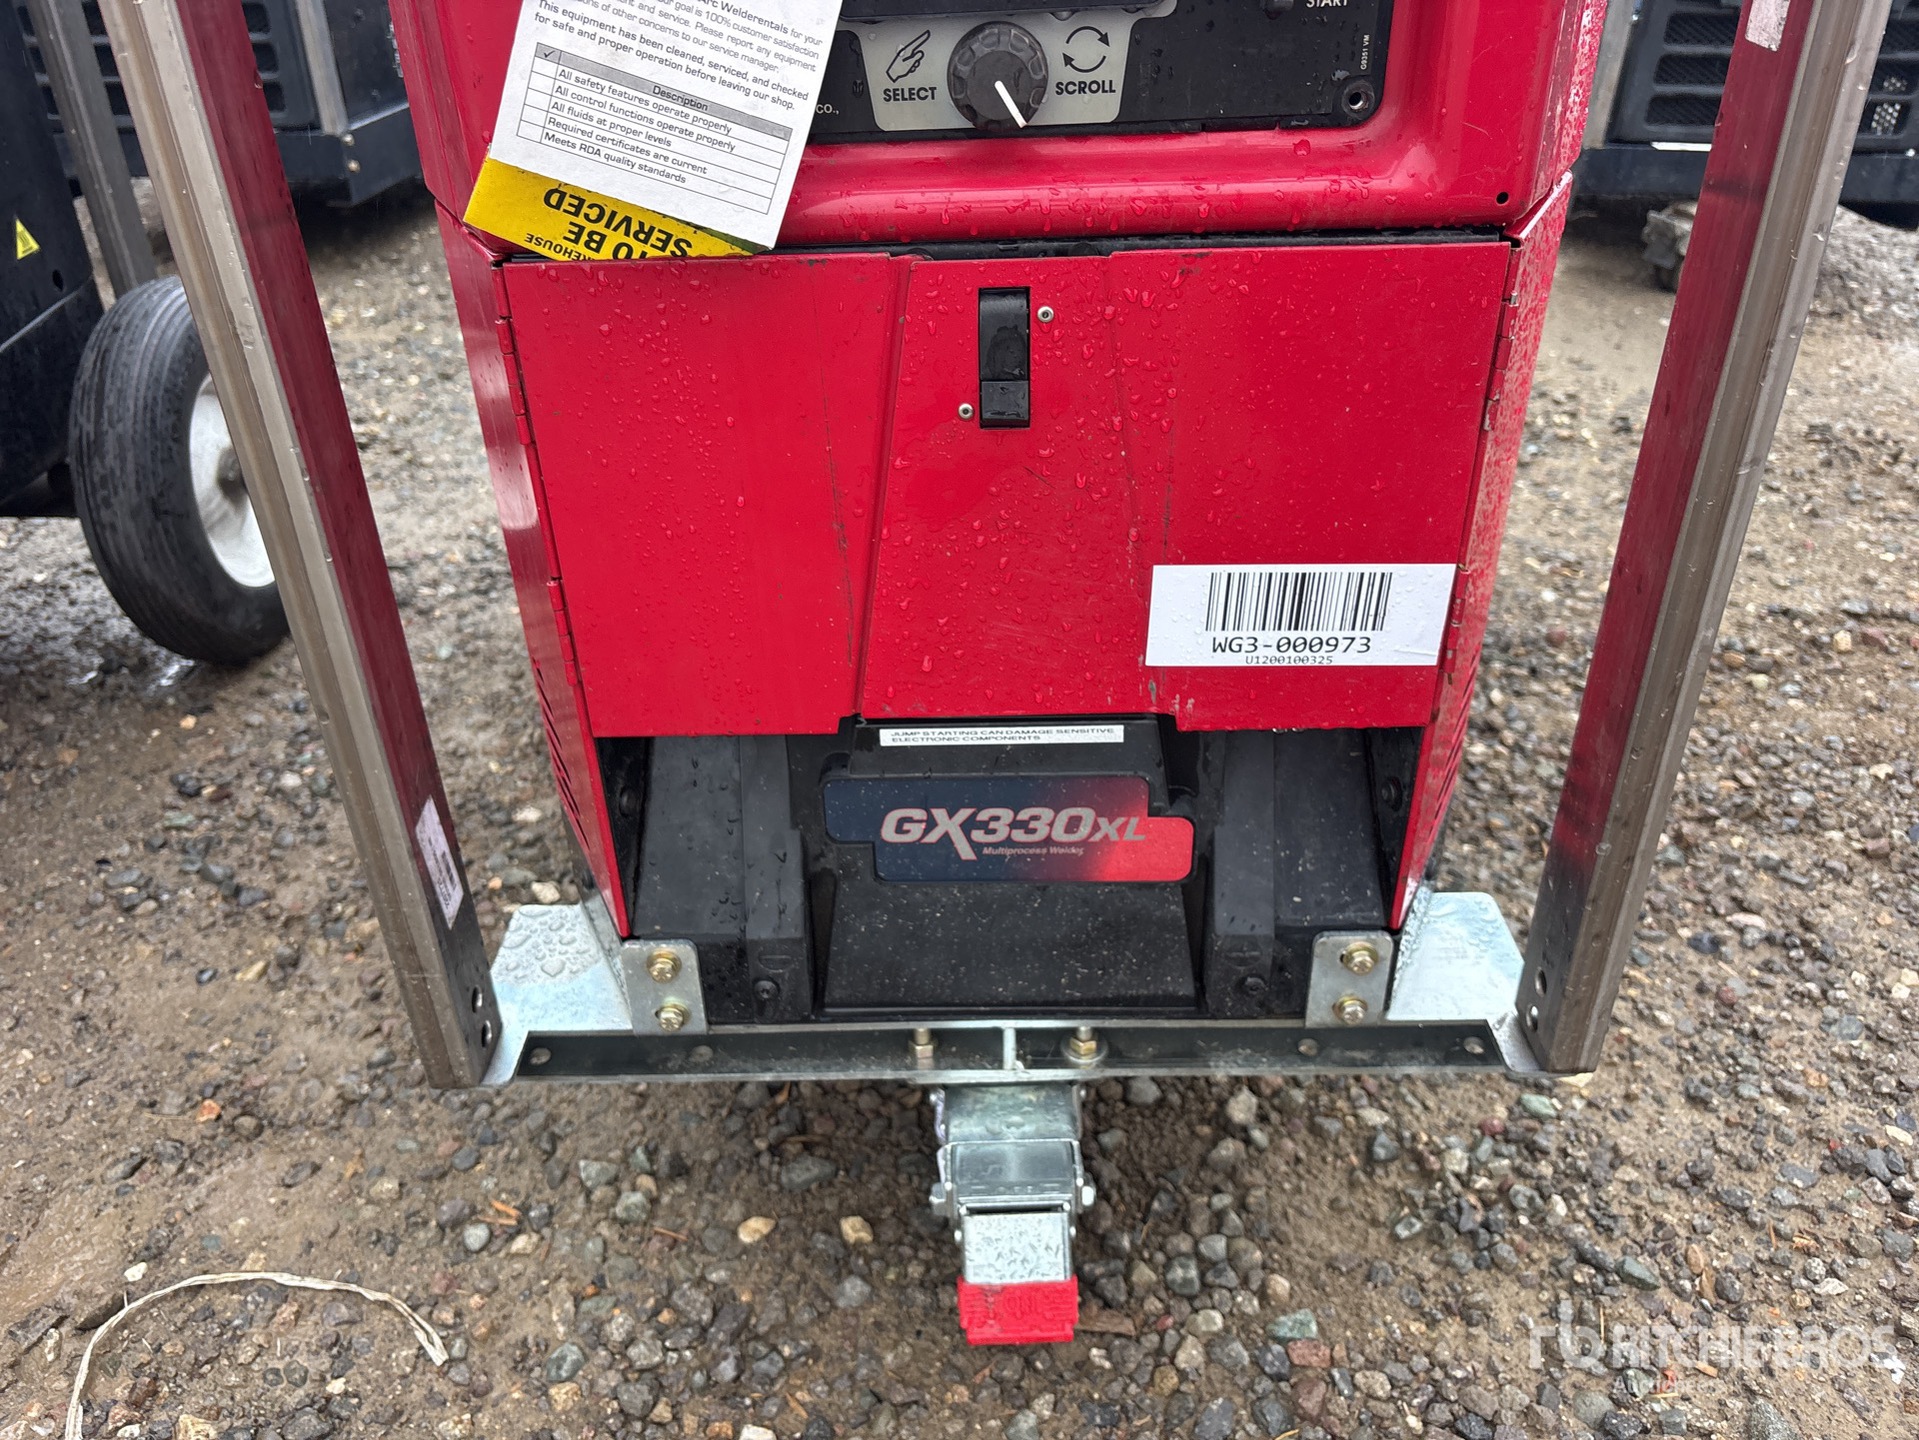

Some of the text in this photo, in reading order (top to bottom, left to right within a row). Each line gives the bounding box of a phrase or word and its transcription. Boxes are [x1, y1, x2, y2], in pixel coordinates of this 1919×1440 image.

[601, 4, 611, 12] of
[612, 8, 637, 21] other
[638, 18, 680, 38] concerns
[682, 32, 691, 41] to
[692, 36, 708, 46] our
[709, 42, 739, 58] service
[740, 54, 779, 74] manager.
[638, 2, 656, 14] and
[658, 10, 691, 28] service.
[695, 22, 724, 38] Please
[726, 35, 754, 50] report
[756, 46, 771, 58] any
[774, 52, 816, 72] equipment
[674, 1, 694, 14] goal
[695, 6, 703, 17] is
[705, 11, 731, 28] 100%
[732, 23, 772, 42] customer
[773, 38, 819, 60] satisfaction
[721, 1, 788, 34] Welderentals
[790, 28, 803, 38] for
[804, 35, 823, 46] your
[534, 12, 794, 110] for safe and proper operation before leaving our shop.
[539, 0, 809, 101] This equipment has been cleaned, serviced, and checked
[558, 69, 732, 136] All safety features operate properly
[652, 85, 708, 112] Description
[883, 87, 937, 102] SELECT
[1055, 78, 1116, 97] SCROLL
[551, 102, 672, 147] All fluids at proper levels
[555, 86, 736, 152] All control functions operate properly
[544, 132, 686, 184] Meets RDA quality standards
[548, 116, 708, 175] Required certificates are current
[544, 188, 692, 258] SERVICED
[563, 221, 607, 254] BE
[1212, 636, 1372, 654] WG3-000973
[1245, 656, 1333, 665] U1200100325
[982, 846, 1084, 855] Multiprocess Welder
